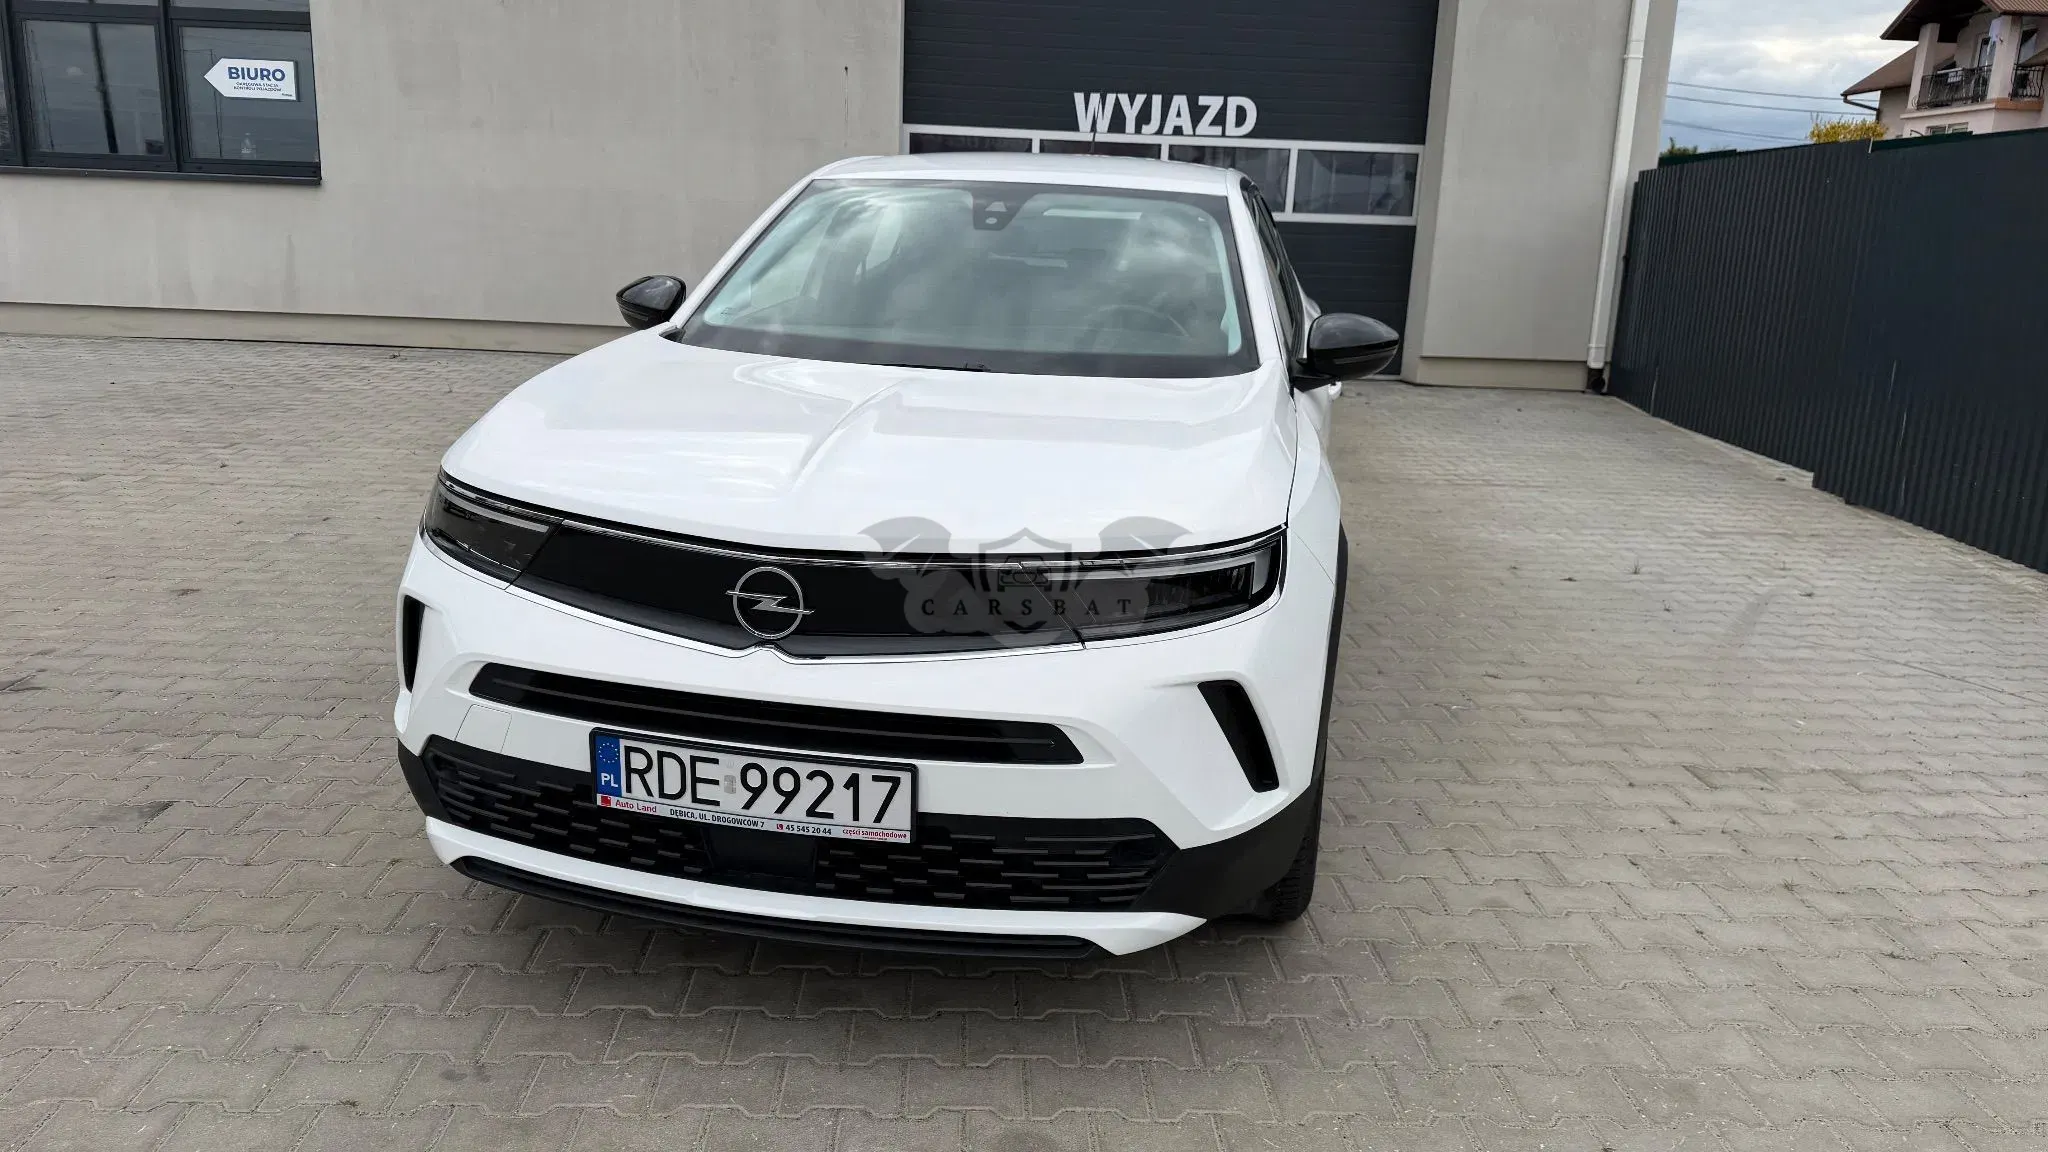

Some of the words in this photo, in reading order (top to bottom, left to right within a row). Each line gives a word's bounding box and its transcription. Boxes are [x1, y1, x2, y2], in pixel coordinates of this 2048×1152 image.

[227, 66, 286, 82] BIURO
[1073, 92, 1258, 137] WYJAZD
[600, 772, 619, 788] PL
[624, 745, 721, 807] RDE
[740, 762, 901, 824] 99217
[615, 799, 635, 809] Auto
[636, 803, 657, 813] Land
[698, 812, 711, 821] UL.
[785, 824, 795, 832] 45
[796, 825, 810, 833] 545
[811, 826, 821, 834] 20
[861, 830, 907, 839] samochodowe
